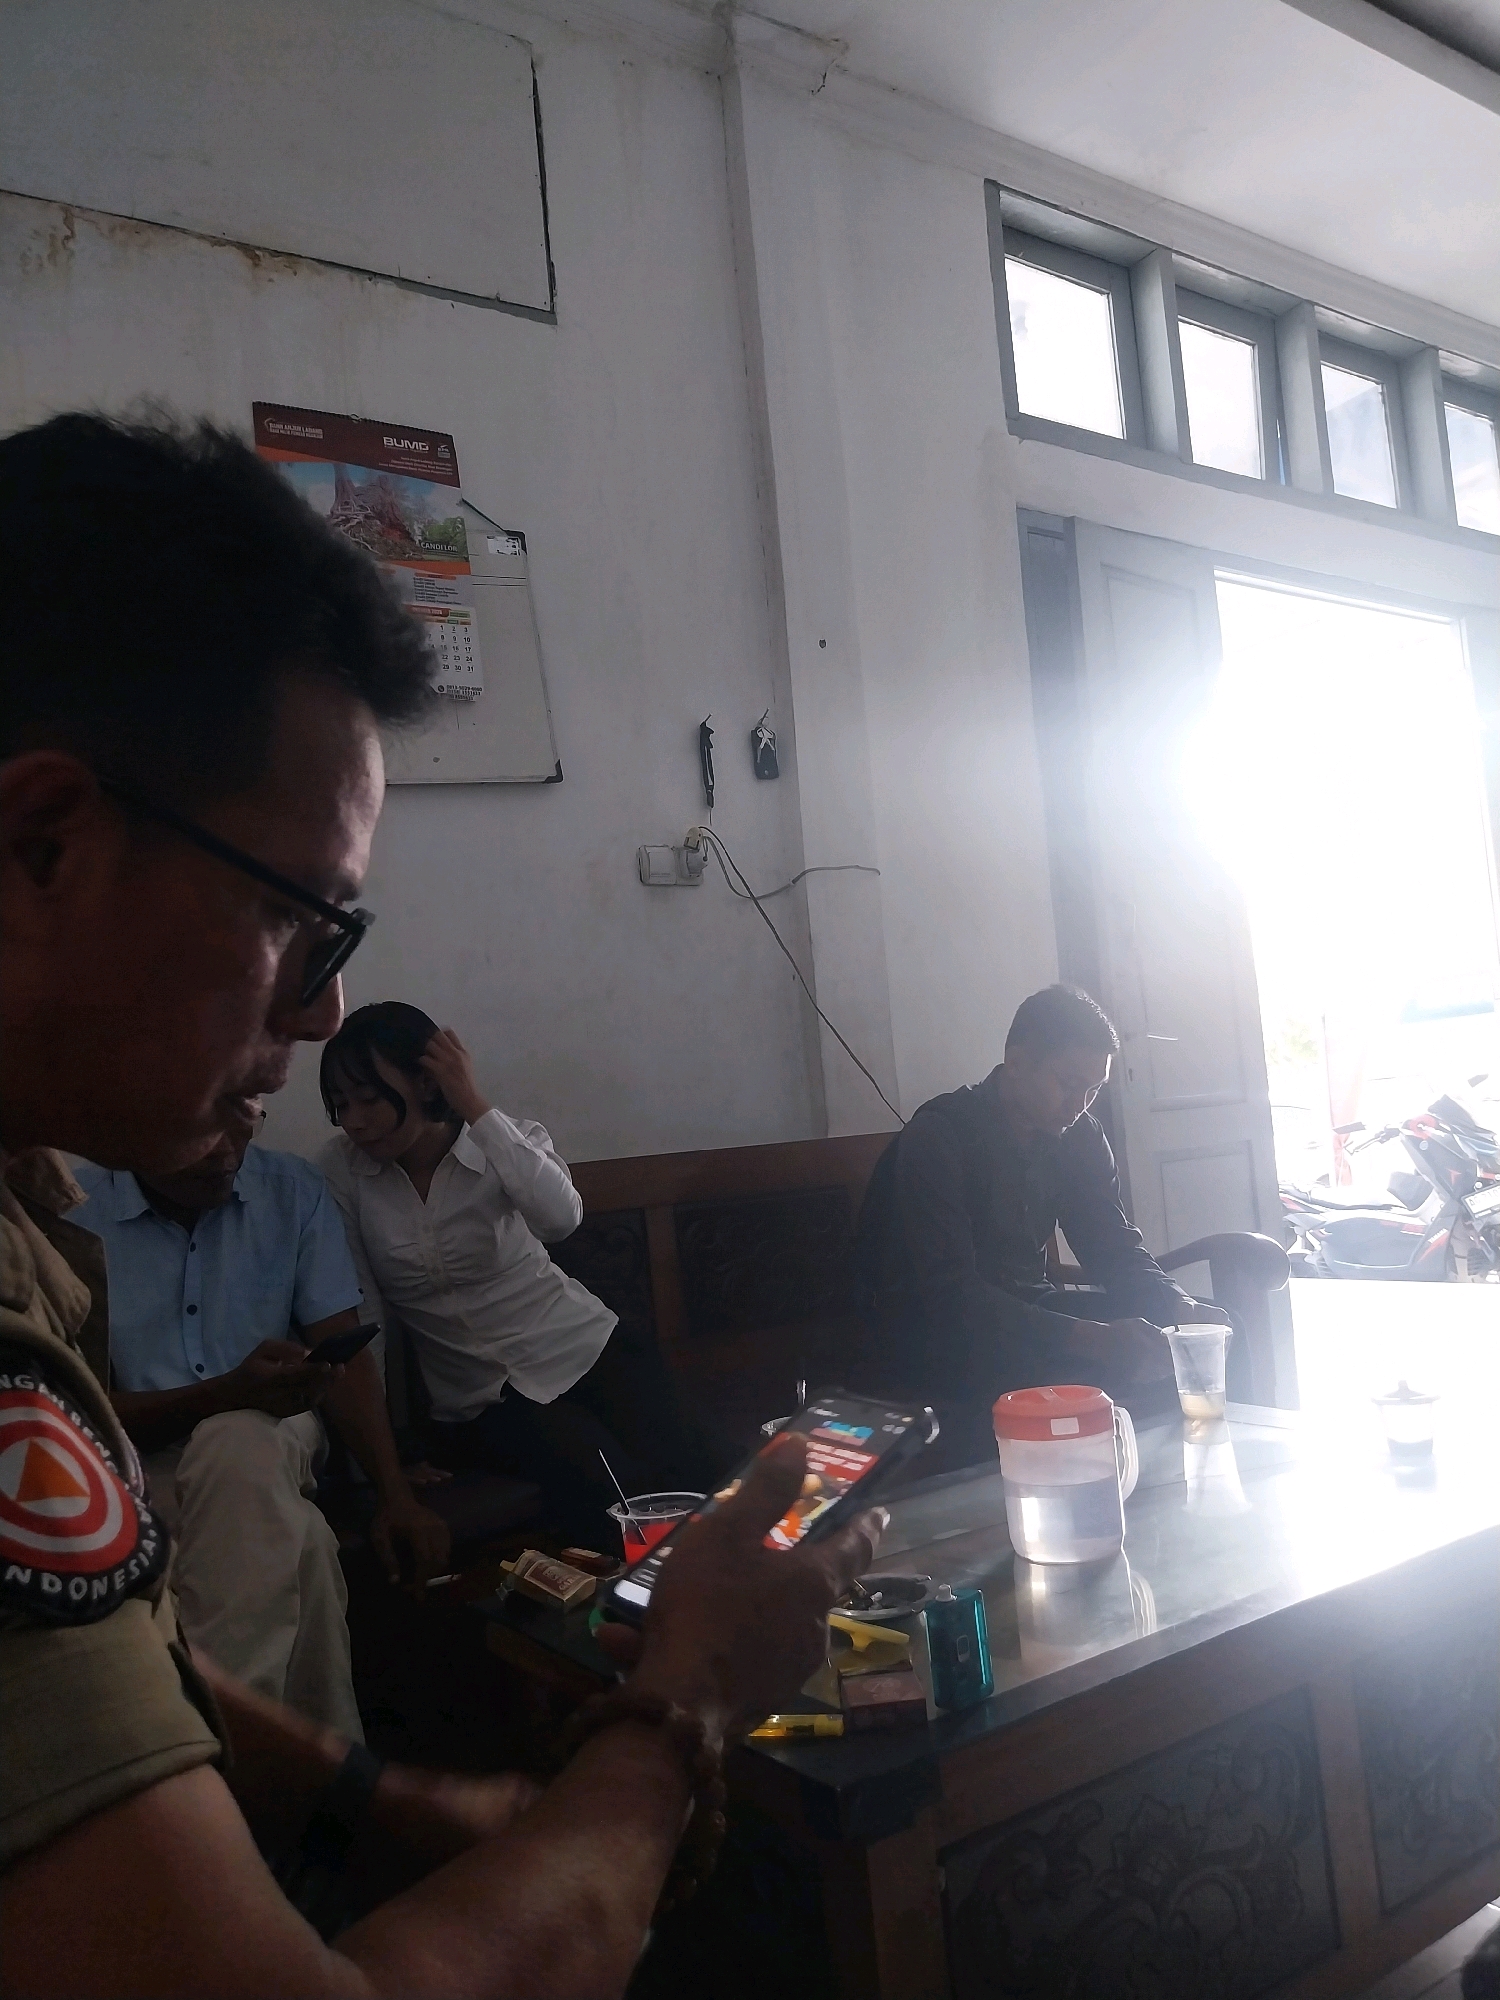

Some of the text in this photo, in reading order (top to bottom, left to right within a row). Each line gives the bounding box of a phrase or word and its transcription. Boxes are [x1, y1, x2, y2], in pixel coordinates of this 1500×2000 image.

[383, 436, 429, 451] BUMD
[420, 542, 458, 552] CANDI LOR
